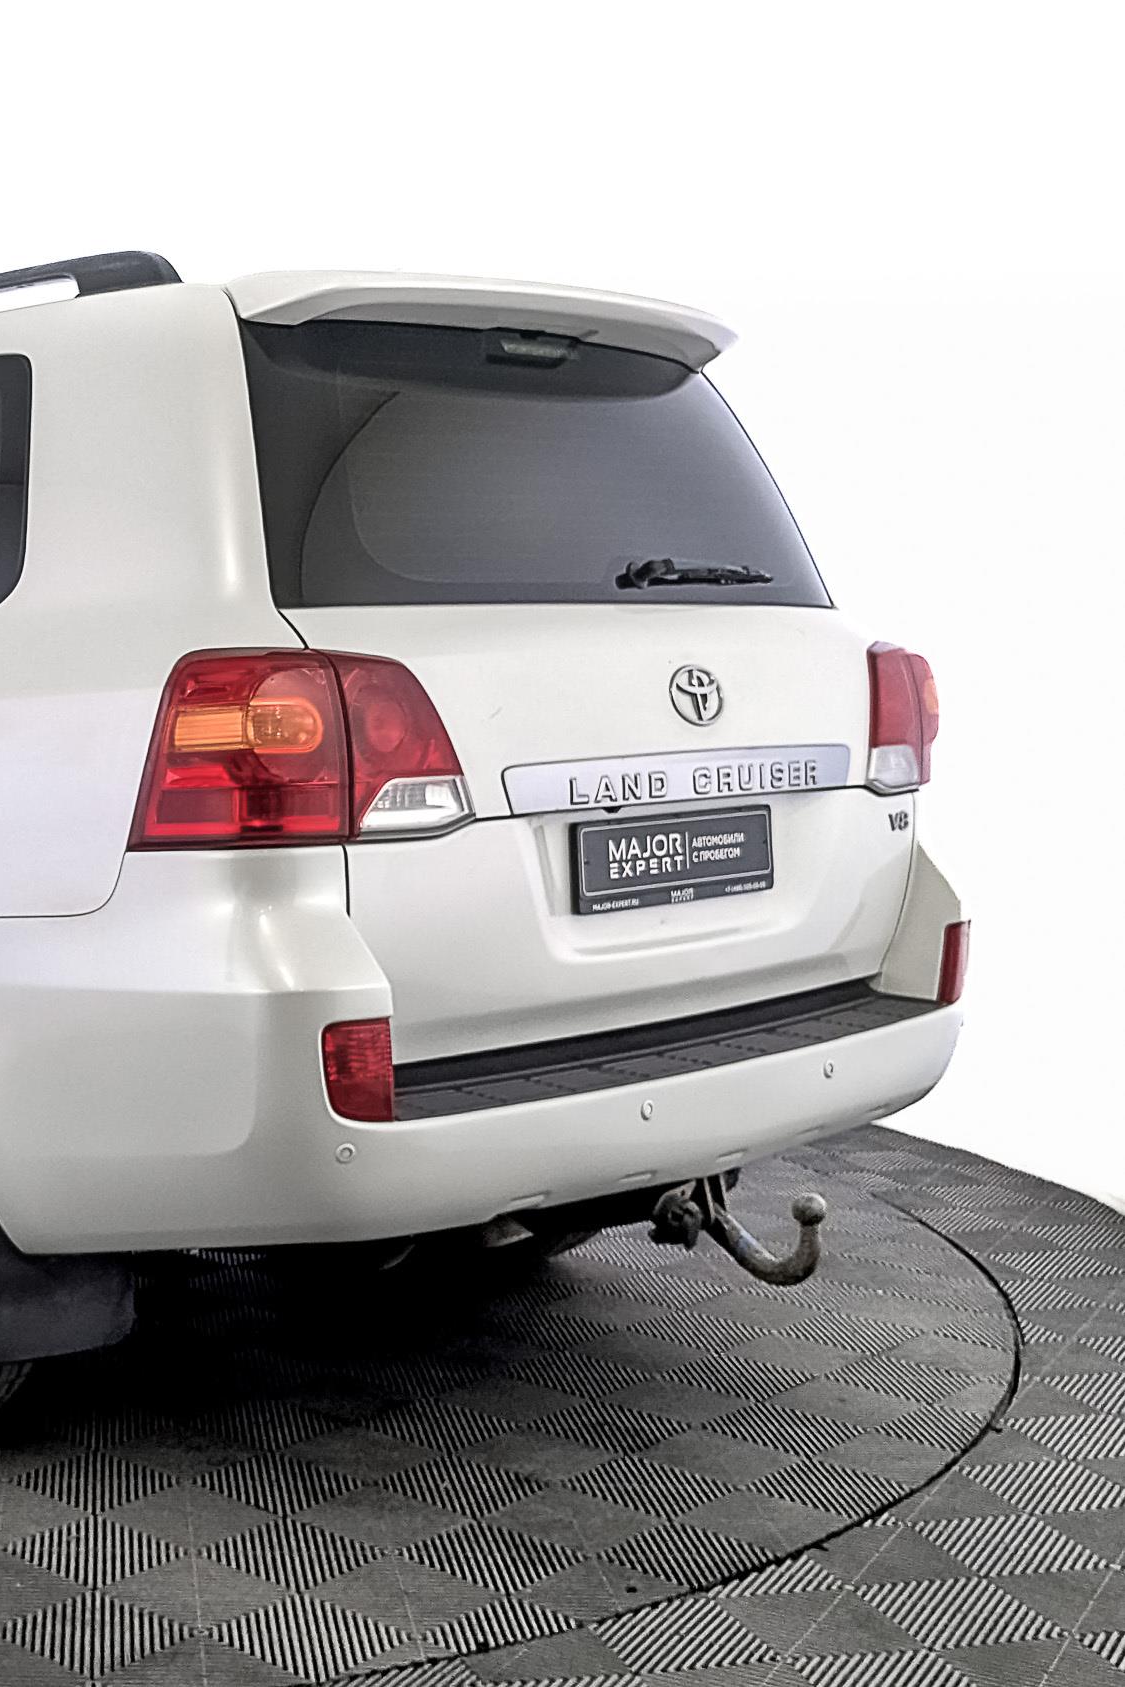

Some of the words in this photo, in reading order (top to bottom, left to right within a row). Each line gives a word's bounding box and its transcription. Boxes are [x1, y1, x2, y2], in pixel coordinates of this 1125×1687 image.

[569, 770, 667, 805] LAND
[693, 760, 817, 795] CRUISER
[888, 810, 909, 831] V8
[608, 833, 683, 862] MAJOR
[691, 832, 745, 848] АВТОМОБИЛИ
[699, 847, 741, 862] ПРОБЕГОМ
[609, 855, 684, 880] EXPERT
